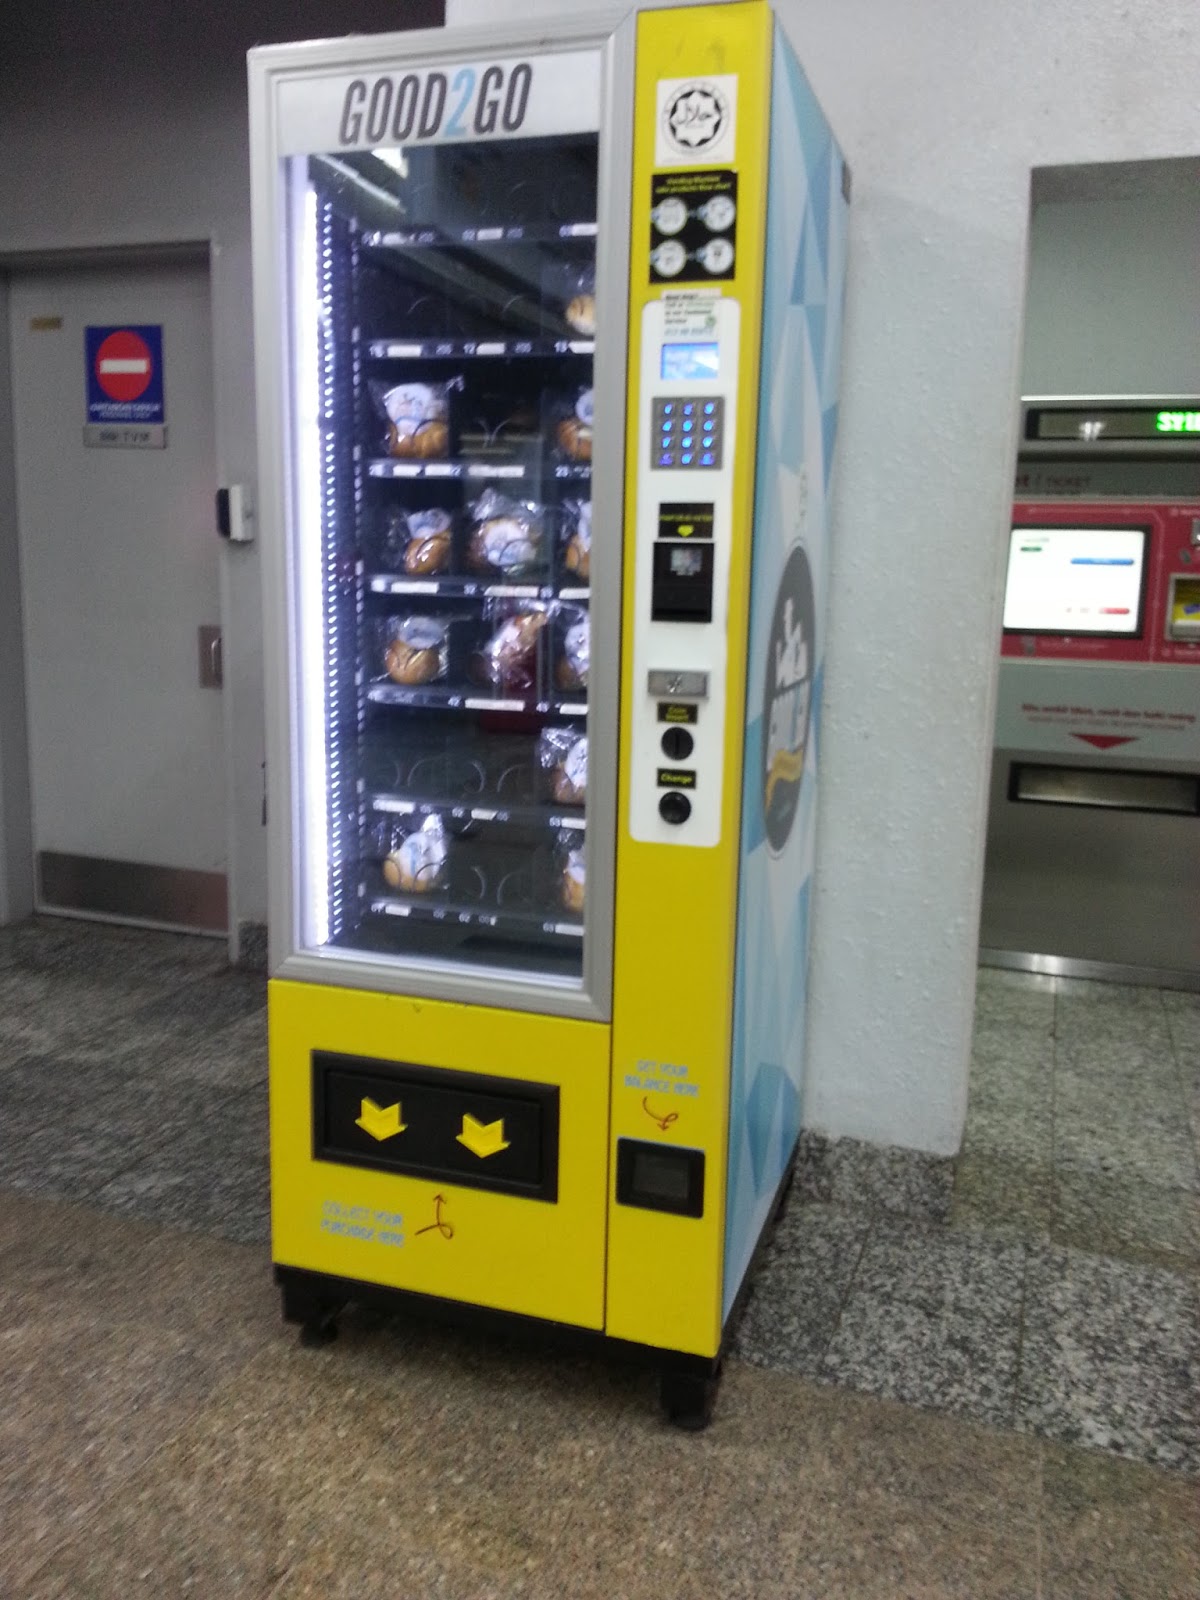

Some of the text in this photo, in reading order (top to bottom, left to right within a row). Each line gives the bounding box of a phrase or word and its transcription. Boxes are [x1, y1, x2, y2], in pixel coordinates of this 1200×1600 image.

[339, 63, 533, 145] GOOD2GO
[660, 773, 693, 785] Change
[659, 1063, 689, 1079] YOUR
[624, 1073, 699, 1098] BALANCE HERE
[322, 1199, 403, 1227] COLLECT YOUR
[319, 1218, 405, 1249] PURCHASE HERE
